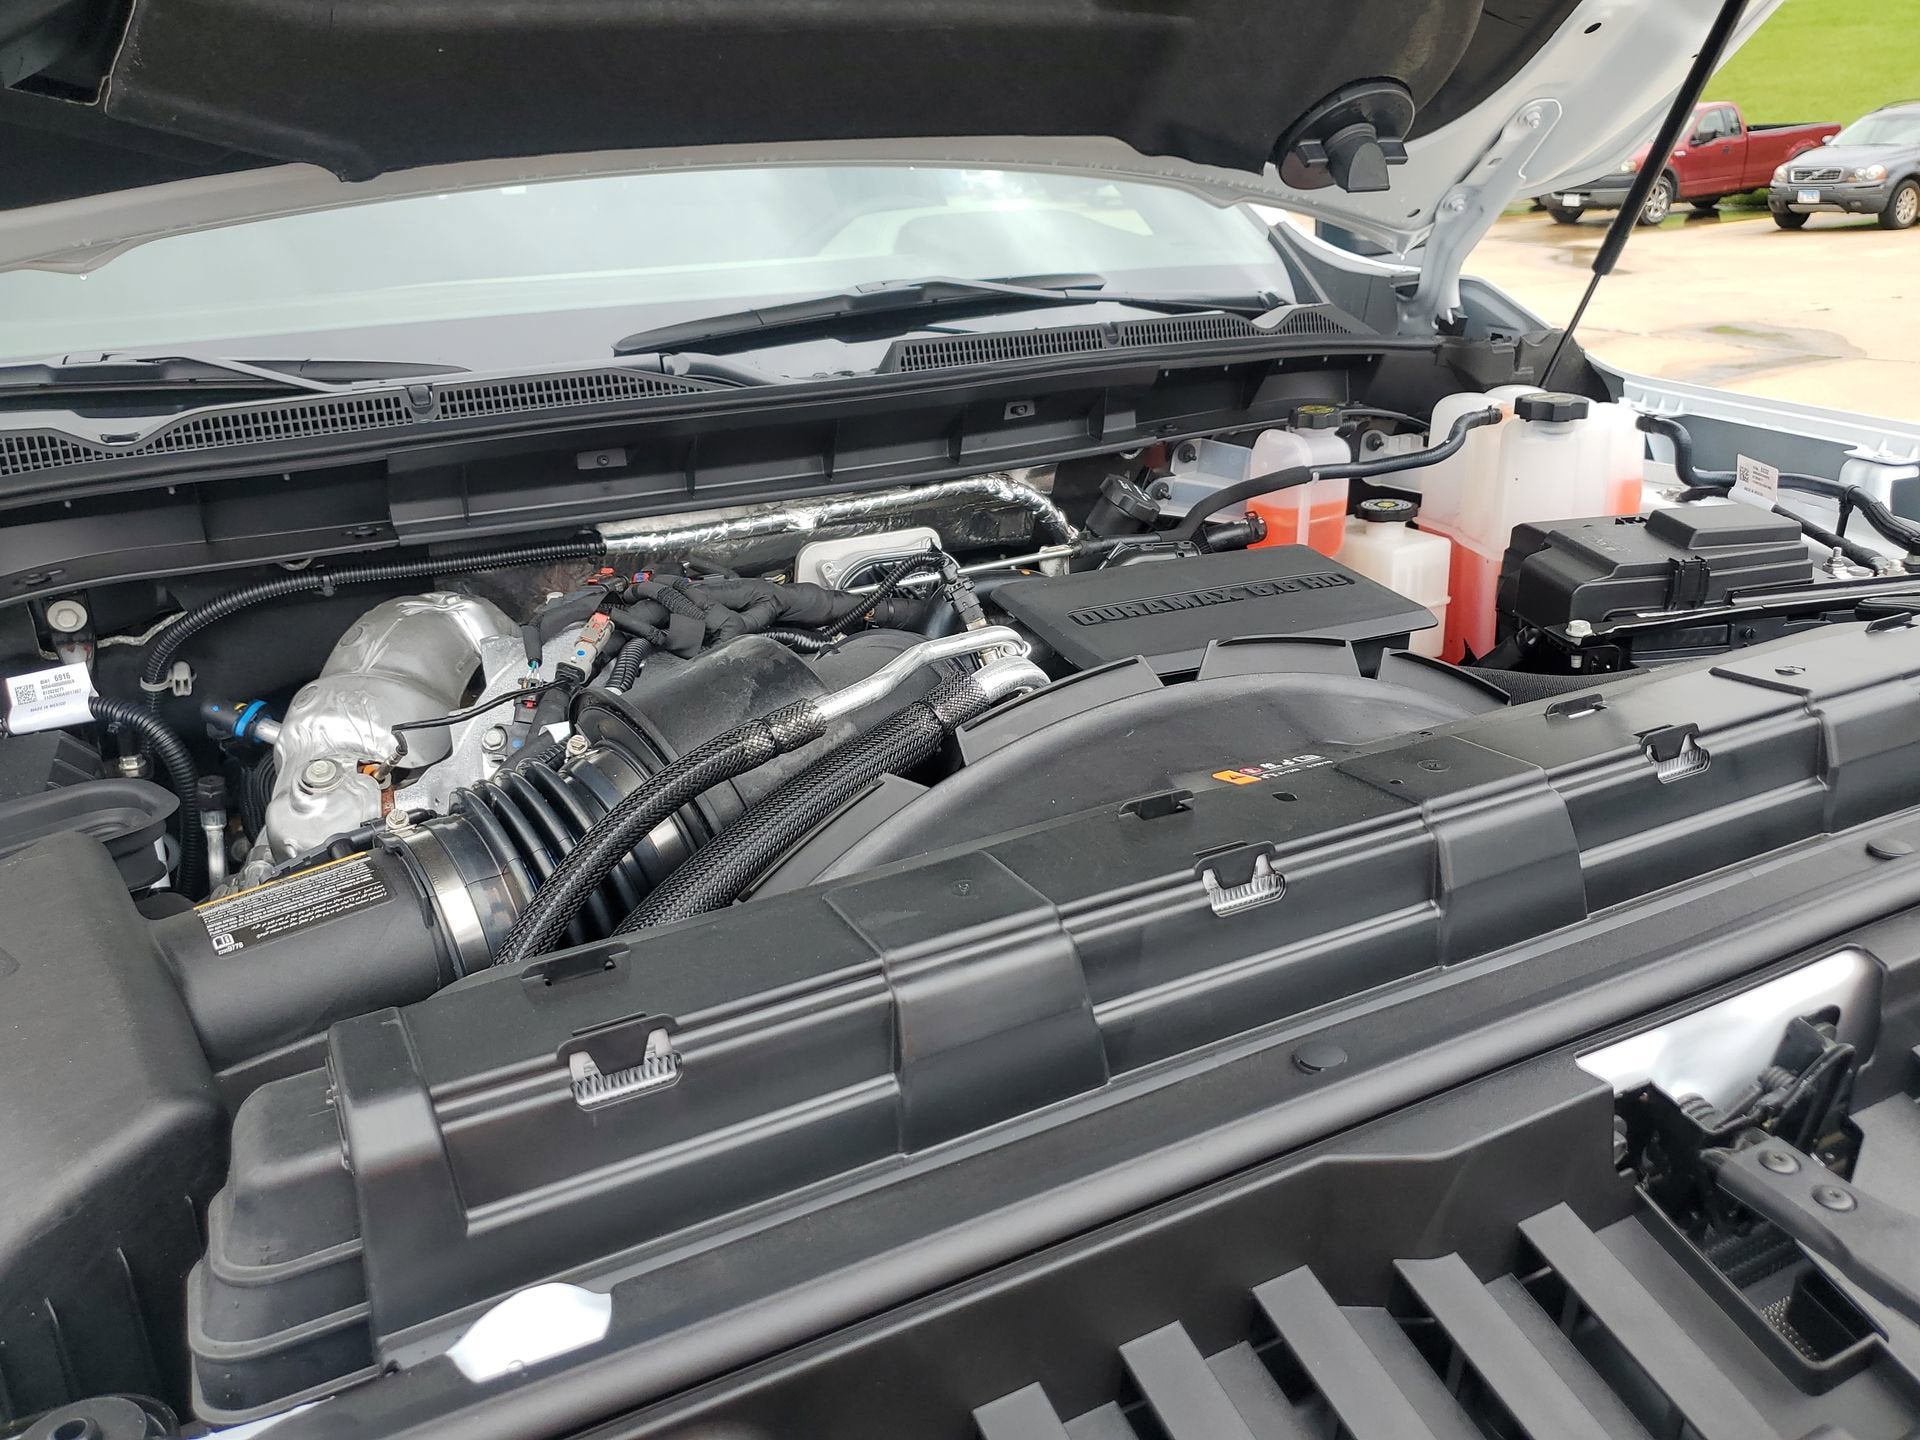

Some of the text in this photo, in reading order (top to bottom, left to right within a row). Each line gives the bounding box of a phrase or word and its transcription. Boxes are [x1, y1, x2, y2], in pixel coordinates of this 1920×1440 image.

[1069, 573, 1349, 626] DURAMAX 6.6 HD
[54, 672, 71, 681] 6916
